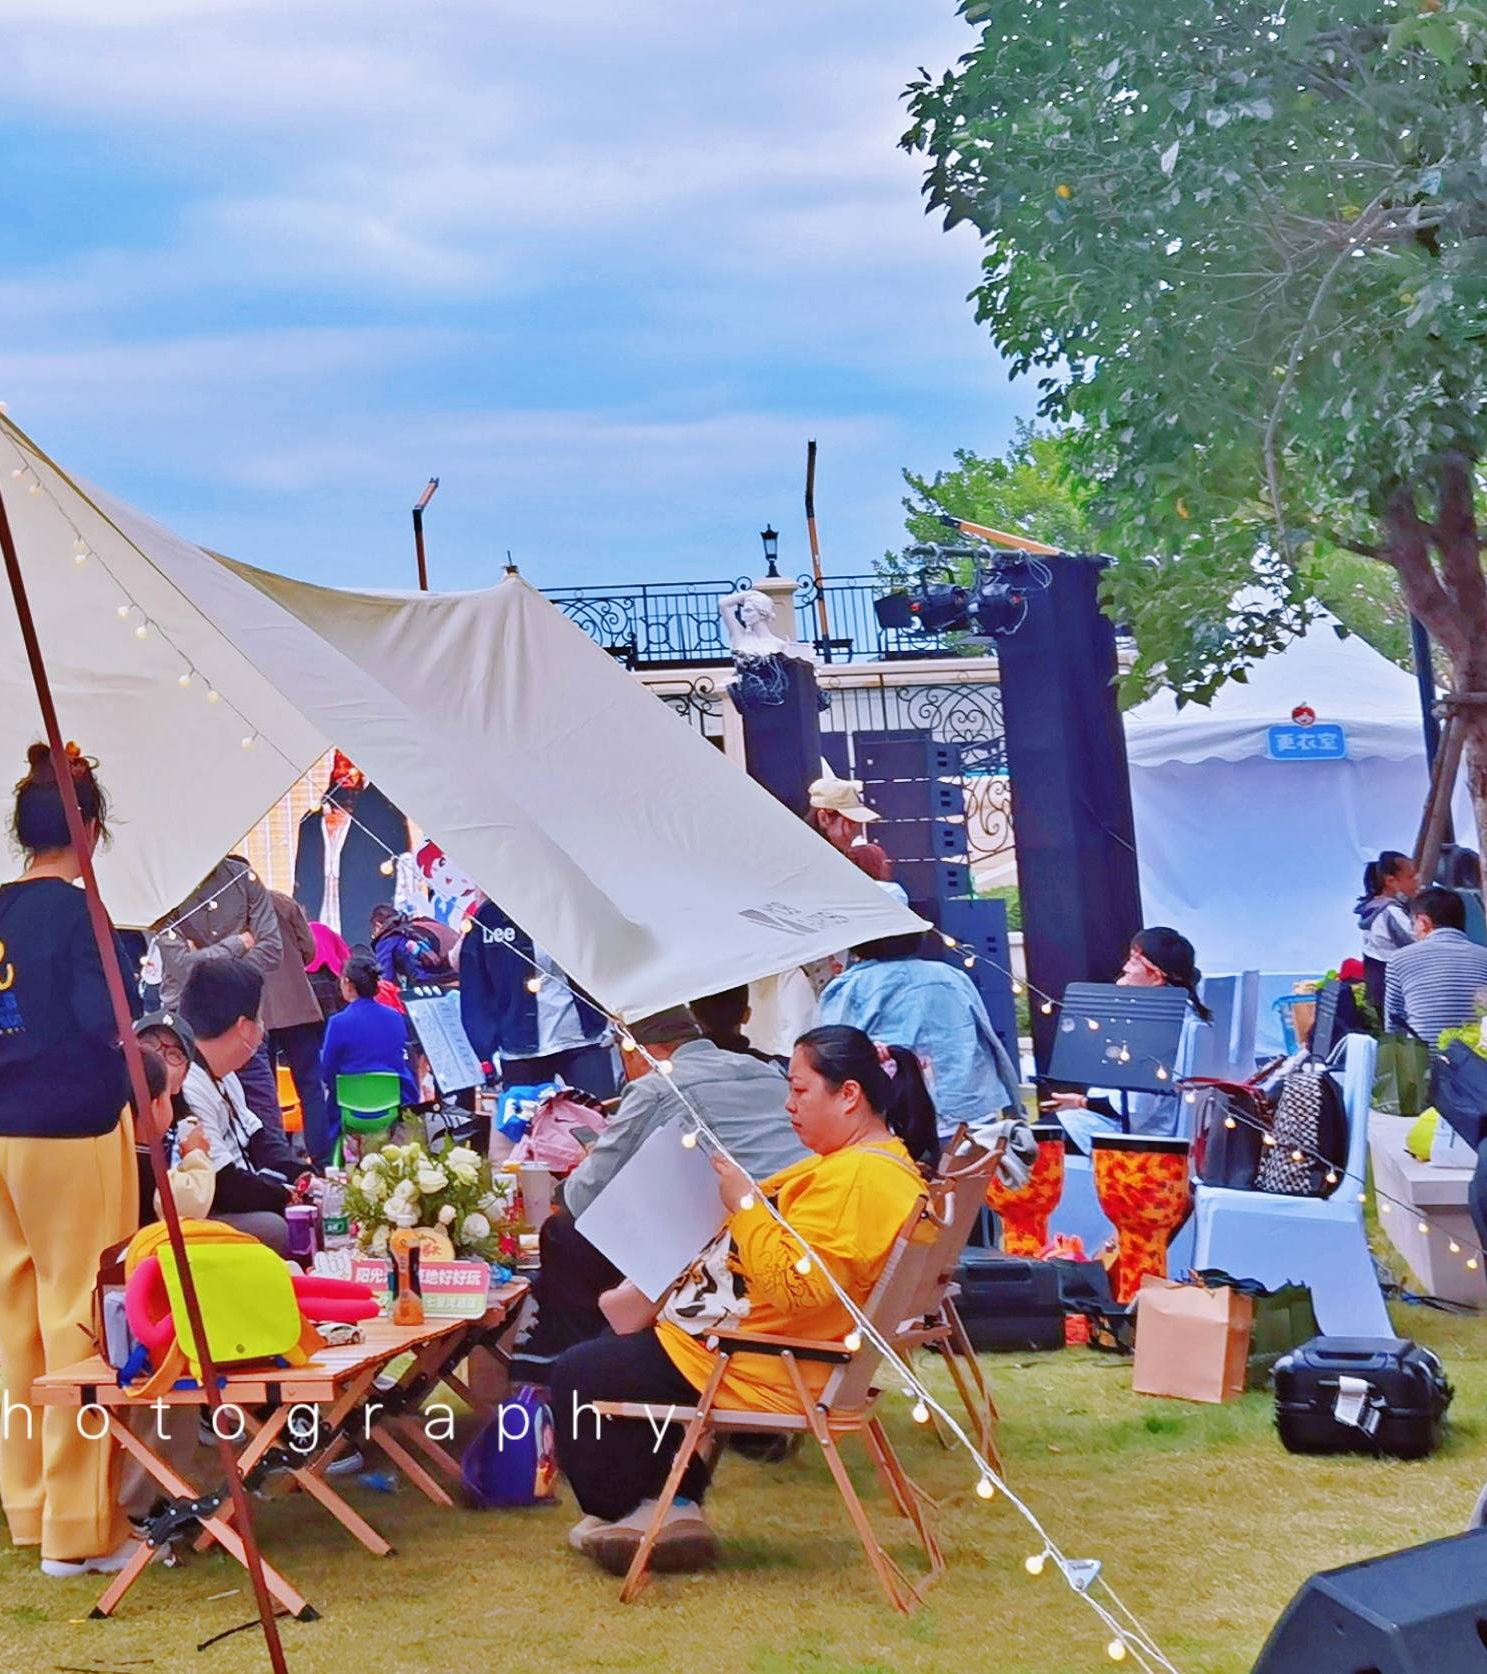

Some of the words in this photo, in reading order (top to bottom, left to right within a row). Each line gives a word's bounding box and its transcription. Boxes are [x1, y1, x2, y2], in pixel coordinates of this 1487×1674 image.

[1274, 732, 1338, 753] 更衣室
[483, 927, 516, 944] Lee
